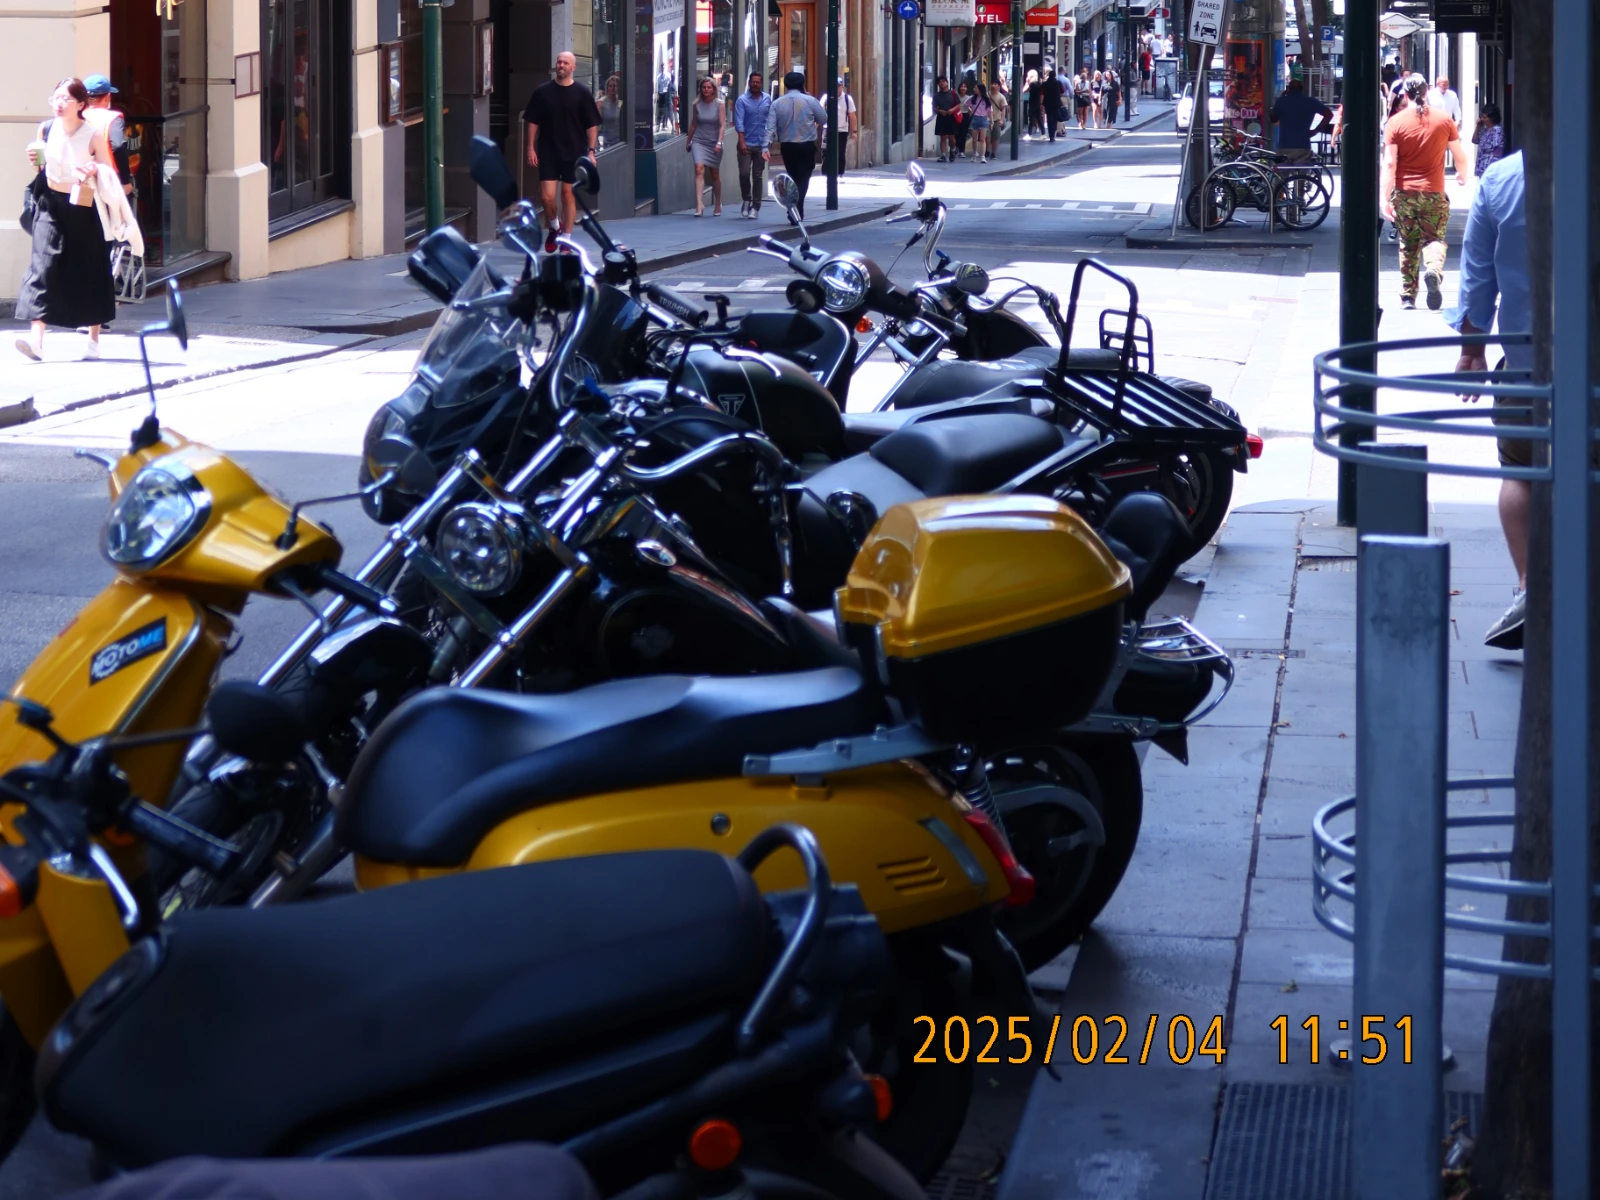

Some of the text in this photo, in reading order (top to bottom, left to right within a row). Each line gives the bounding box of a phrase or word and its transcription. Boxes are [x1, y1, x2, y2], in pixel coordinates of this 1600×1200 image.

[1197, 0, 1221, 11] SHARED
[1199, 11, 1215, 20] ZONE
[1323, 29, 1331, 39] P
[659, 296, 691, 318] TRIUMPH
[91, 624, 165, 679] MOTOME
